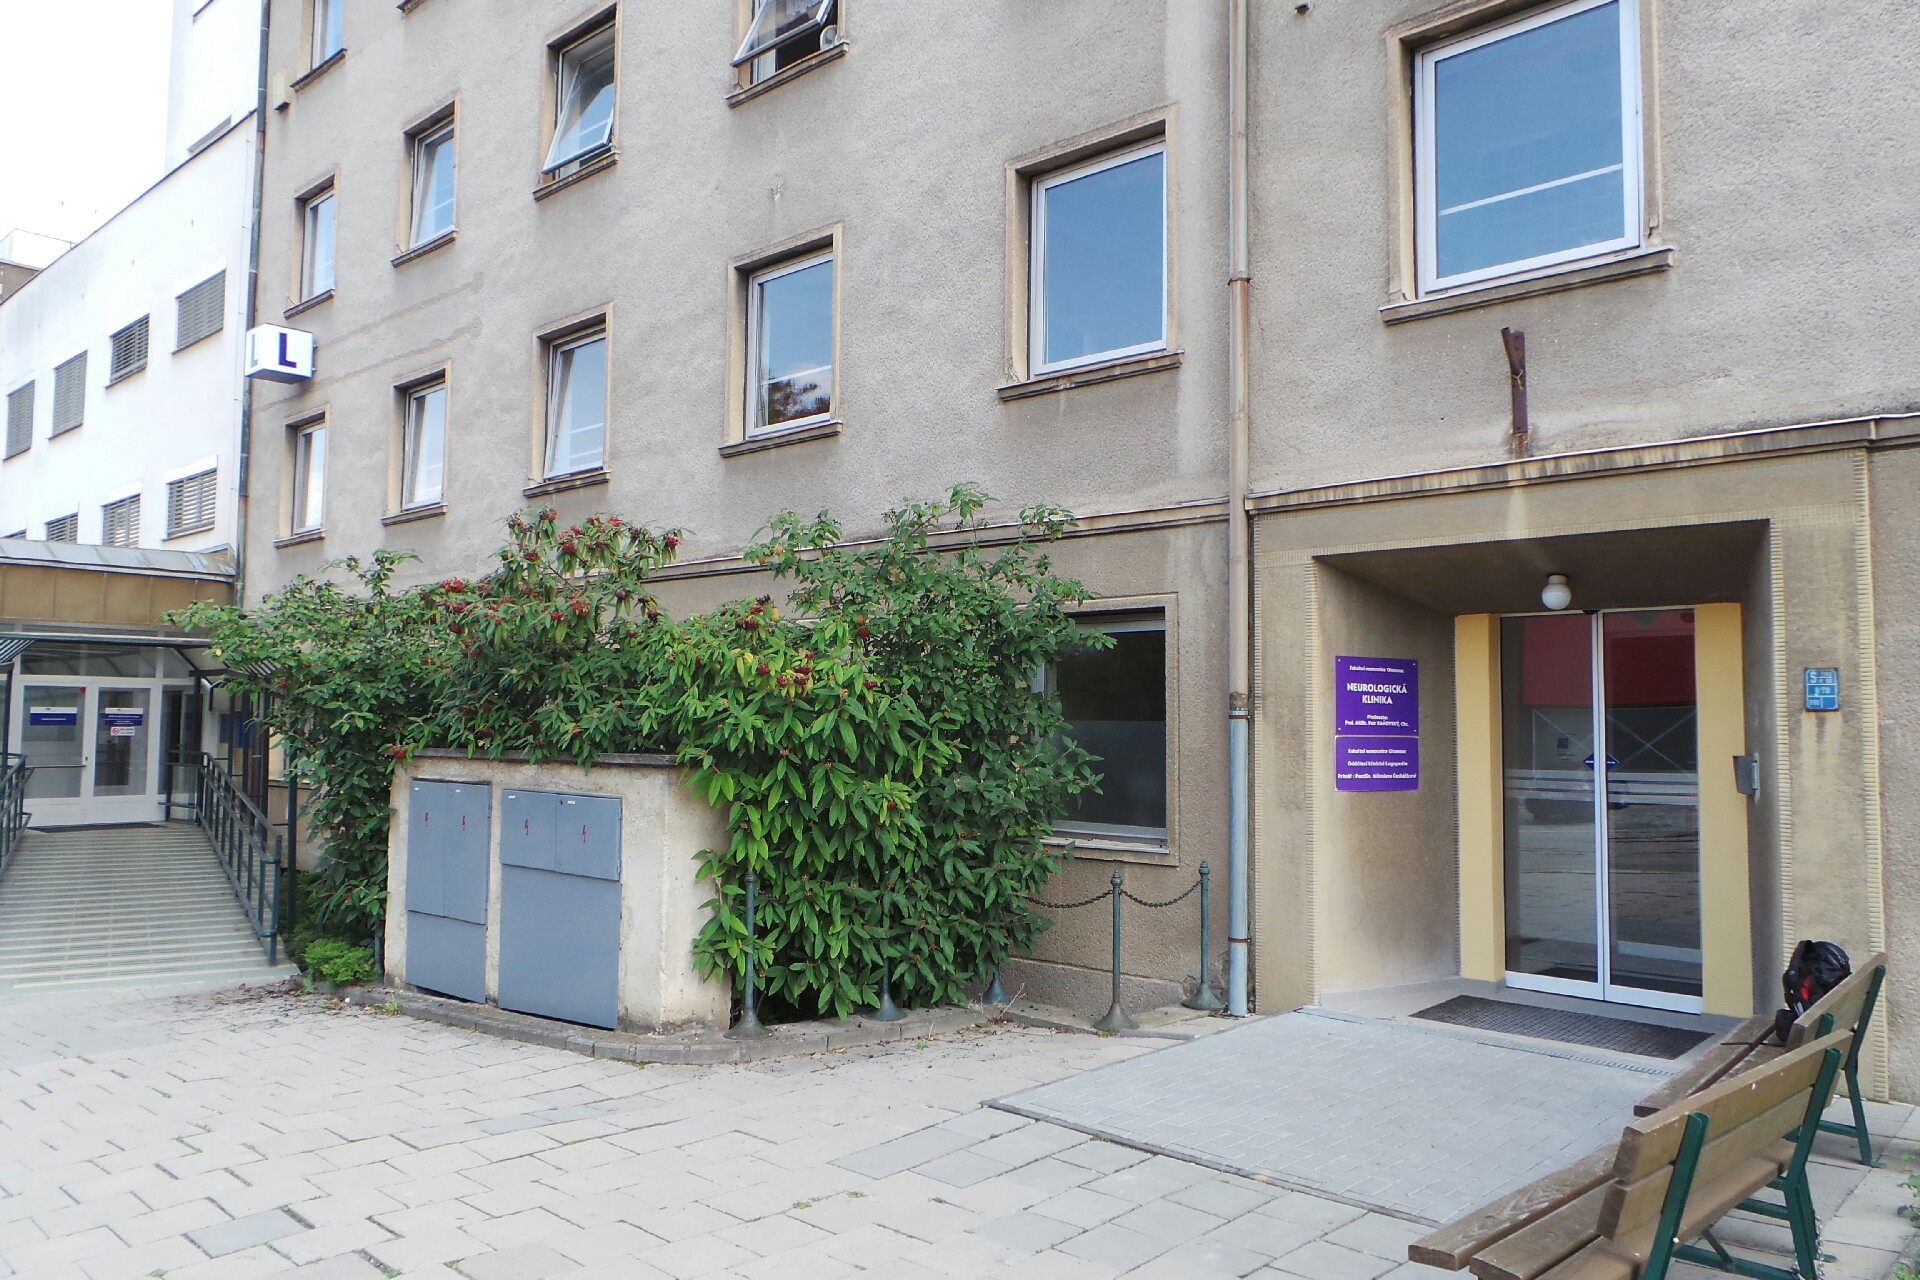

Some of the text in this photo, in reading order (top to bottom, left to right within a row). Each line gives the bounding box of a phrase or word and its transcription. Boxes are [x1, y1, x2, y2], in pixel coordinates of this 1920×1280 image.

[278, 332, 297, 369] L
[1346, 682, 1408, 694] NEUROLOGICKÁ
[1362, 694, 1393, 704] KLINIKA
